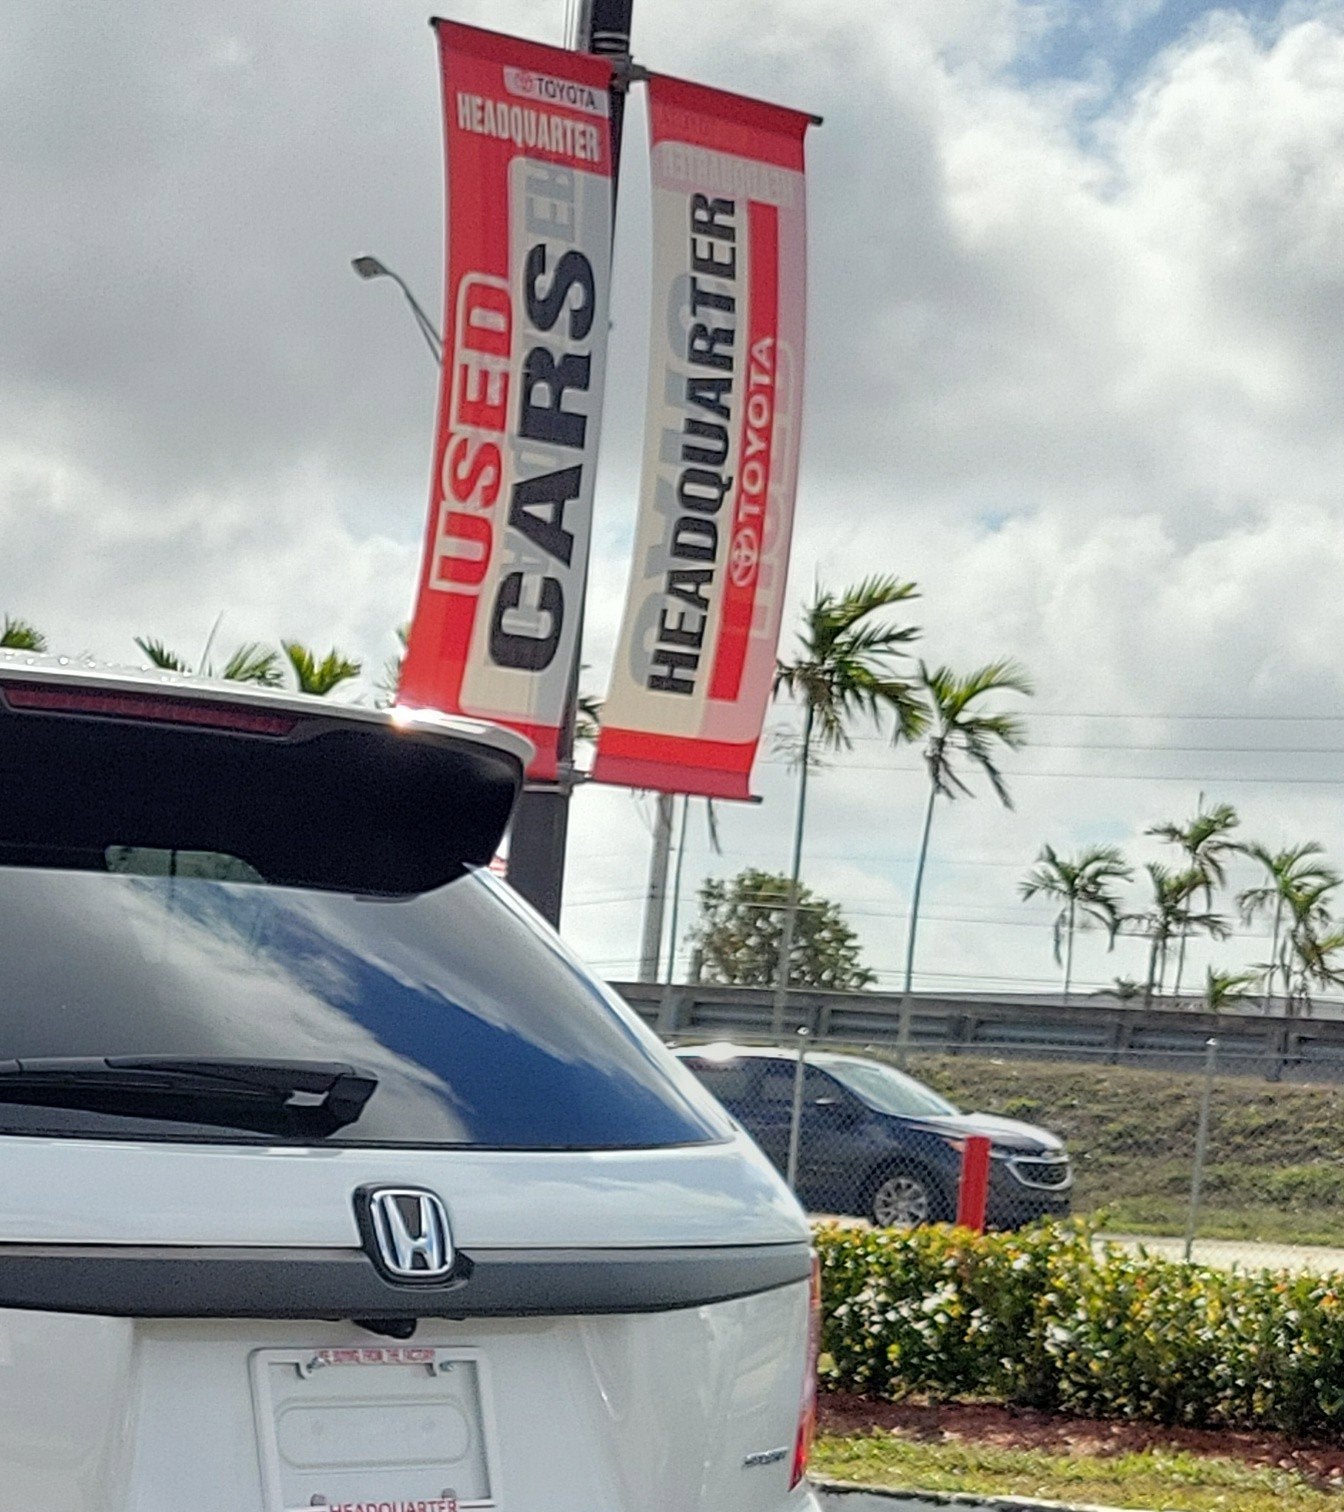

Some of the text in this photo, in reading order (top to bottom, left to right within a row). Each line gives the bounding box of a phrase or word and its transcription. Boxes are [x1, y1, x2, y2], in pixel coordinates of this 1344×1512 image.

[457, 93, 600, 161] HEADQUARTER
[534, 75, 598, 110] TOYOTA
[429, 272, 510, 595] USED
[489, 244, 595, 672] CARS
[647, 193, 736, 694] HEADQUARTER
[737, 338, 774, 523] TOYOTA
